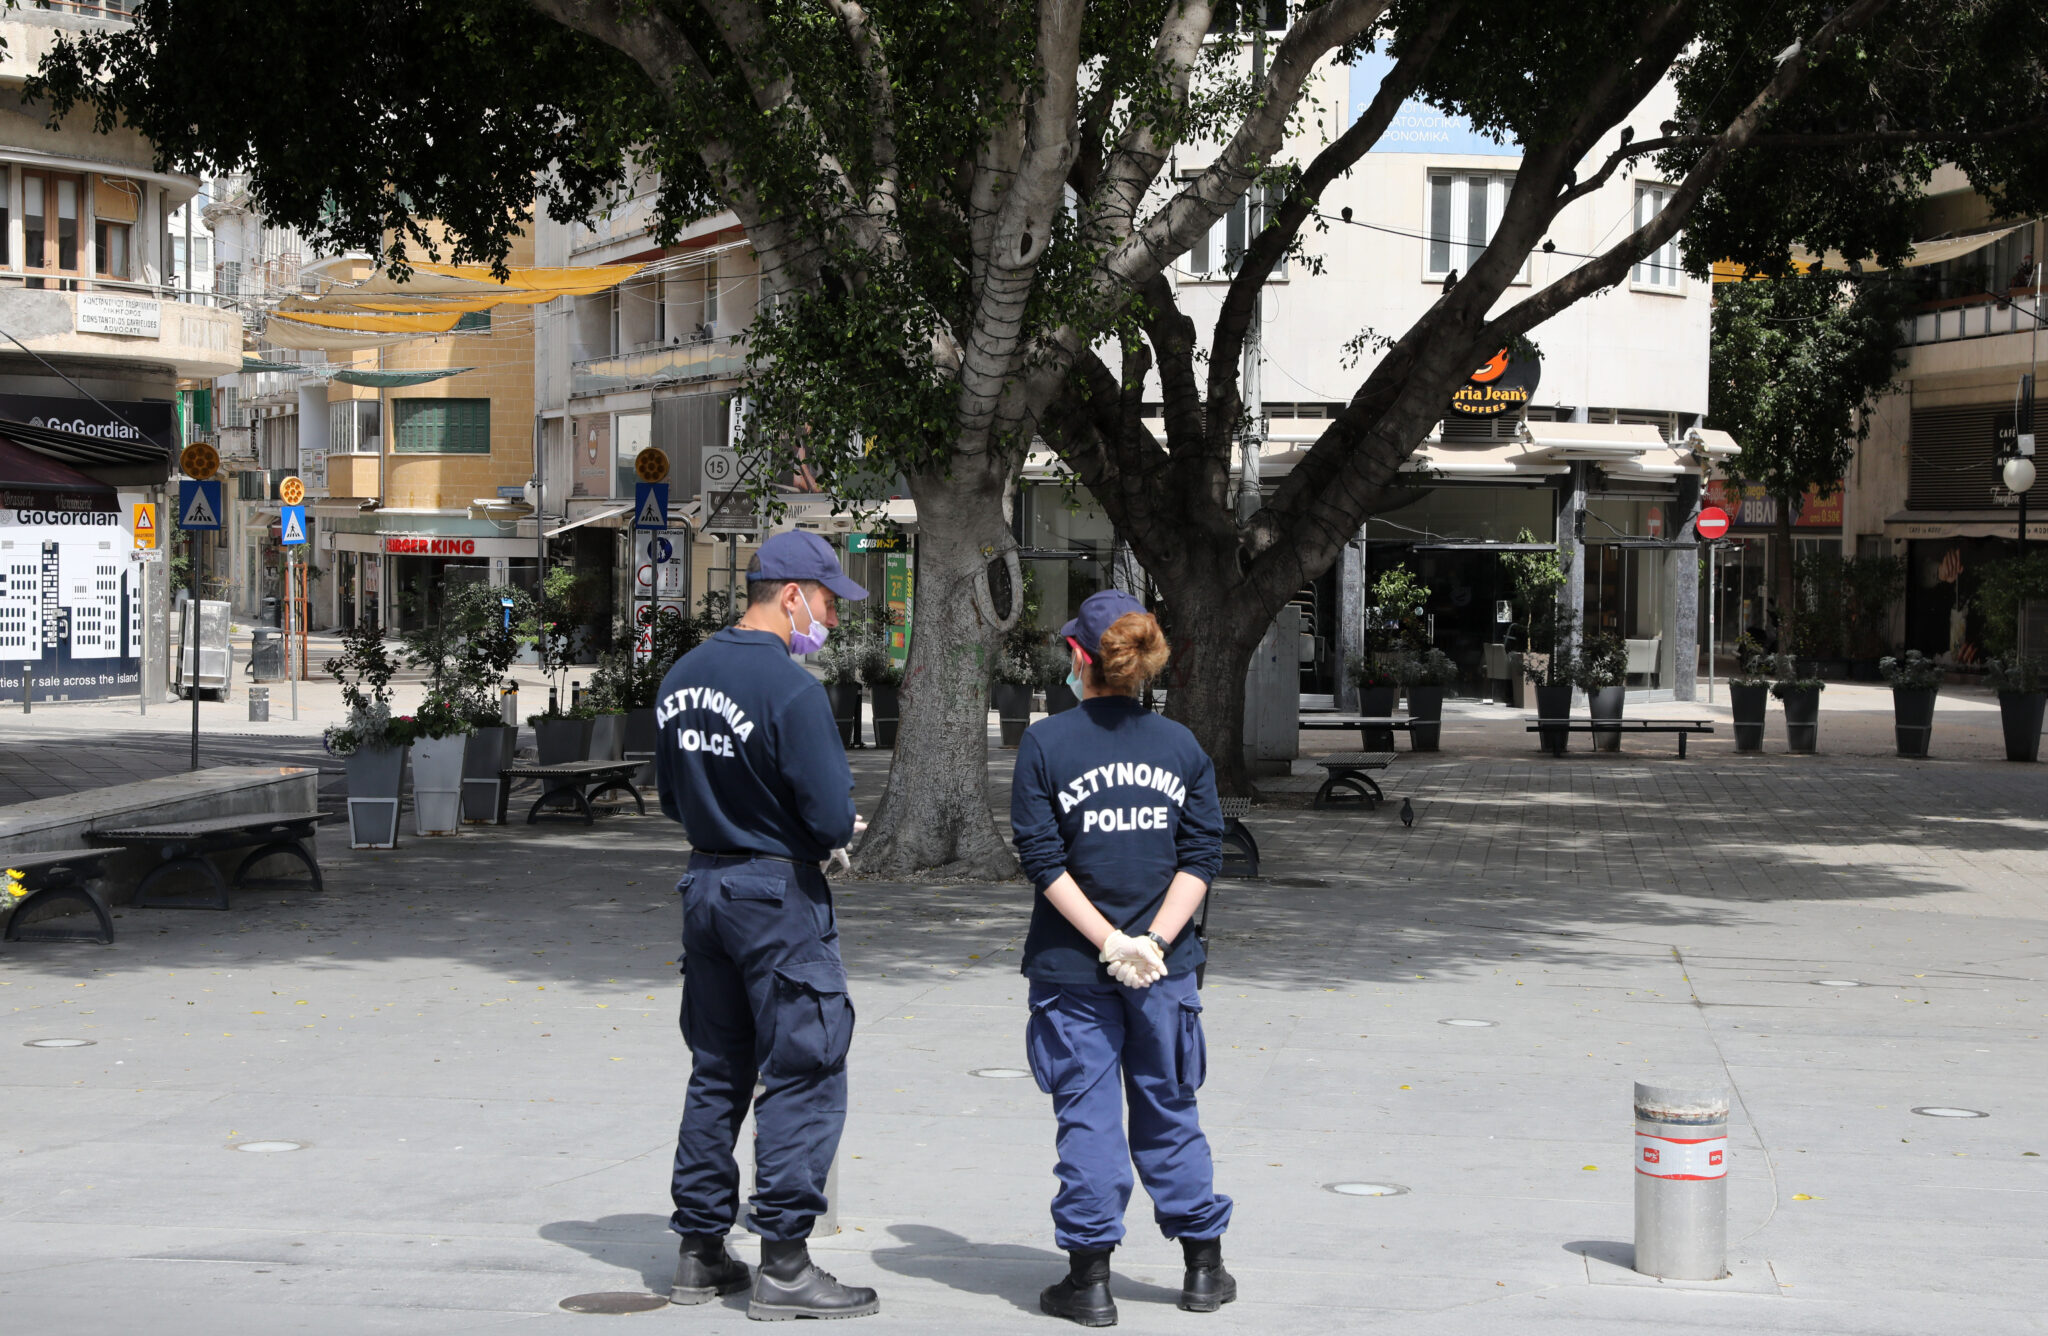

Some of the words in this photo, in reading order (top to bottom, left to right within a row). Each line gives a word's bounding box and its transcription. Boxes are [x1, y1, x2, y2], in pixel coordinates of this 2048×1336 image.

[1390, 116, 1461, 128] ΑΤΟΛΟΓΙΚΑ
[1381, 130, 1449, 142] ΡΟΝΟΜΙΚΑ
[104, 325, 141, 334] ADVOCATE
[1484, 386, 1528, 401] Jean's
[1454, 401, 1506, 414] COFFEES
[47, 417, 139, 439] GoGordian
[709, 461, 724, 474] 15
[16, 509, 118, 526] GoGordian
[386, 539, 429, 553] BURGER
[430, 540, 475, 555] KING
[857, 538, 899, 548] SUBWAY
[38, 676, 60, 686] sale
[63, 677, 96, 686] across
[99, 674, 114, 684] the
[117, 672, 138, 684] island
[656, 687, 755, 743] ΑΣΤΥΝΟΜΙΑ
[1058, 762, 1186, 814] ΑΣΤΥΝΟΜΙΑ
[1083, 806, 1168, 833] POLICE
